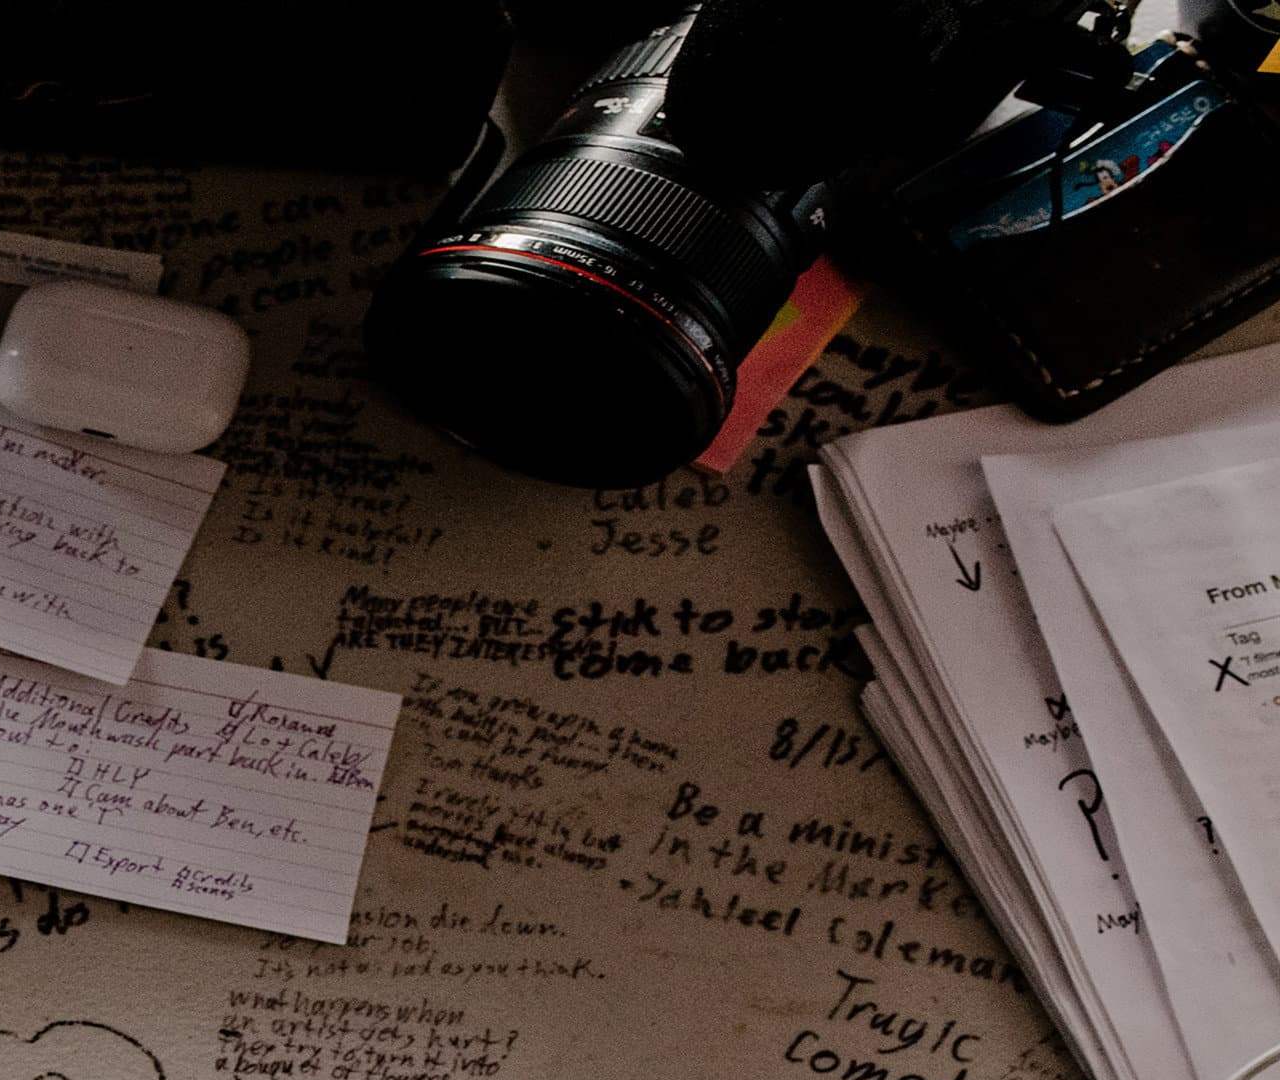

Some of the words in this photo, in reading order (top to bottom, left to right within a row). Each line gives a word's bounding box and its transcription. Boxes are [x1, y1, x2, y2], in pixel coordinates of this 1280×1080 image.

[590, 518, 723, 559] Jesse
[926, 515, 983, 545] Maybe
[11, 587, 73, 622] with
[1205, 578, 1268, 605] From
[673, 599, 734, 635] to
[1226, 629, 1263, 647] Tag
[552, 641, 694, 682] come
[39, 799, 78, 821] one
[142, 796, 203, 824] about
[667, 780, 722, 827] Be
[90, 846, 166, 881] Export
[708, 836, 788, 885] the
[36, 891, 90, 936] do
[826, 967, 986, 1064] Tragic
[427, 1029, 520, 1061] hurt?
